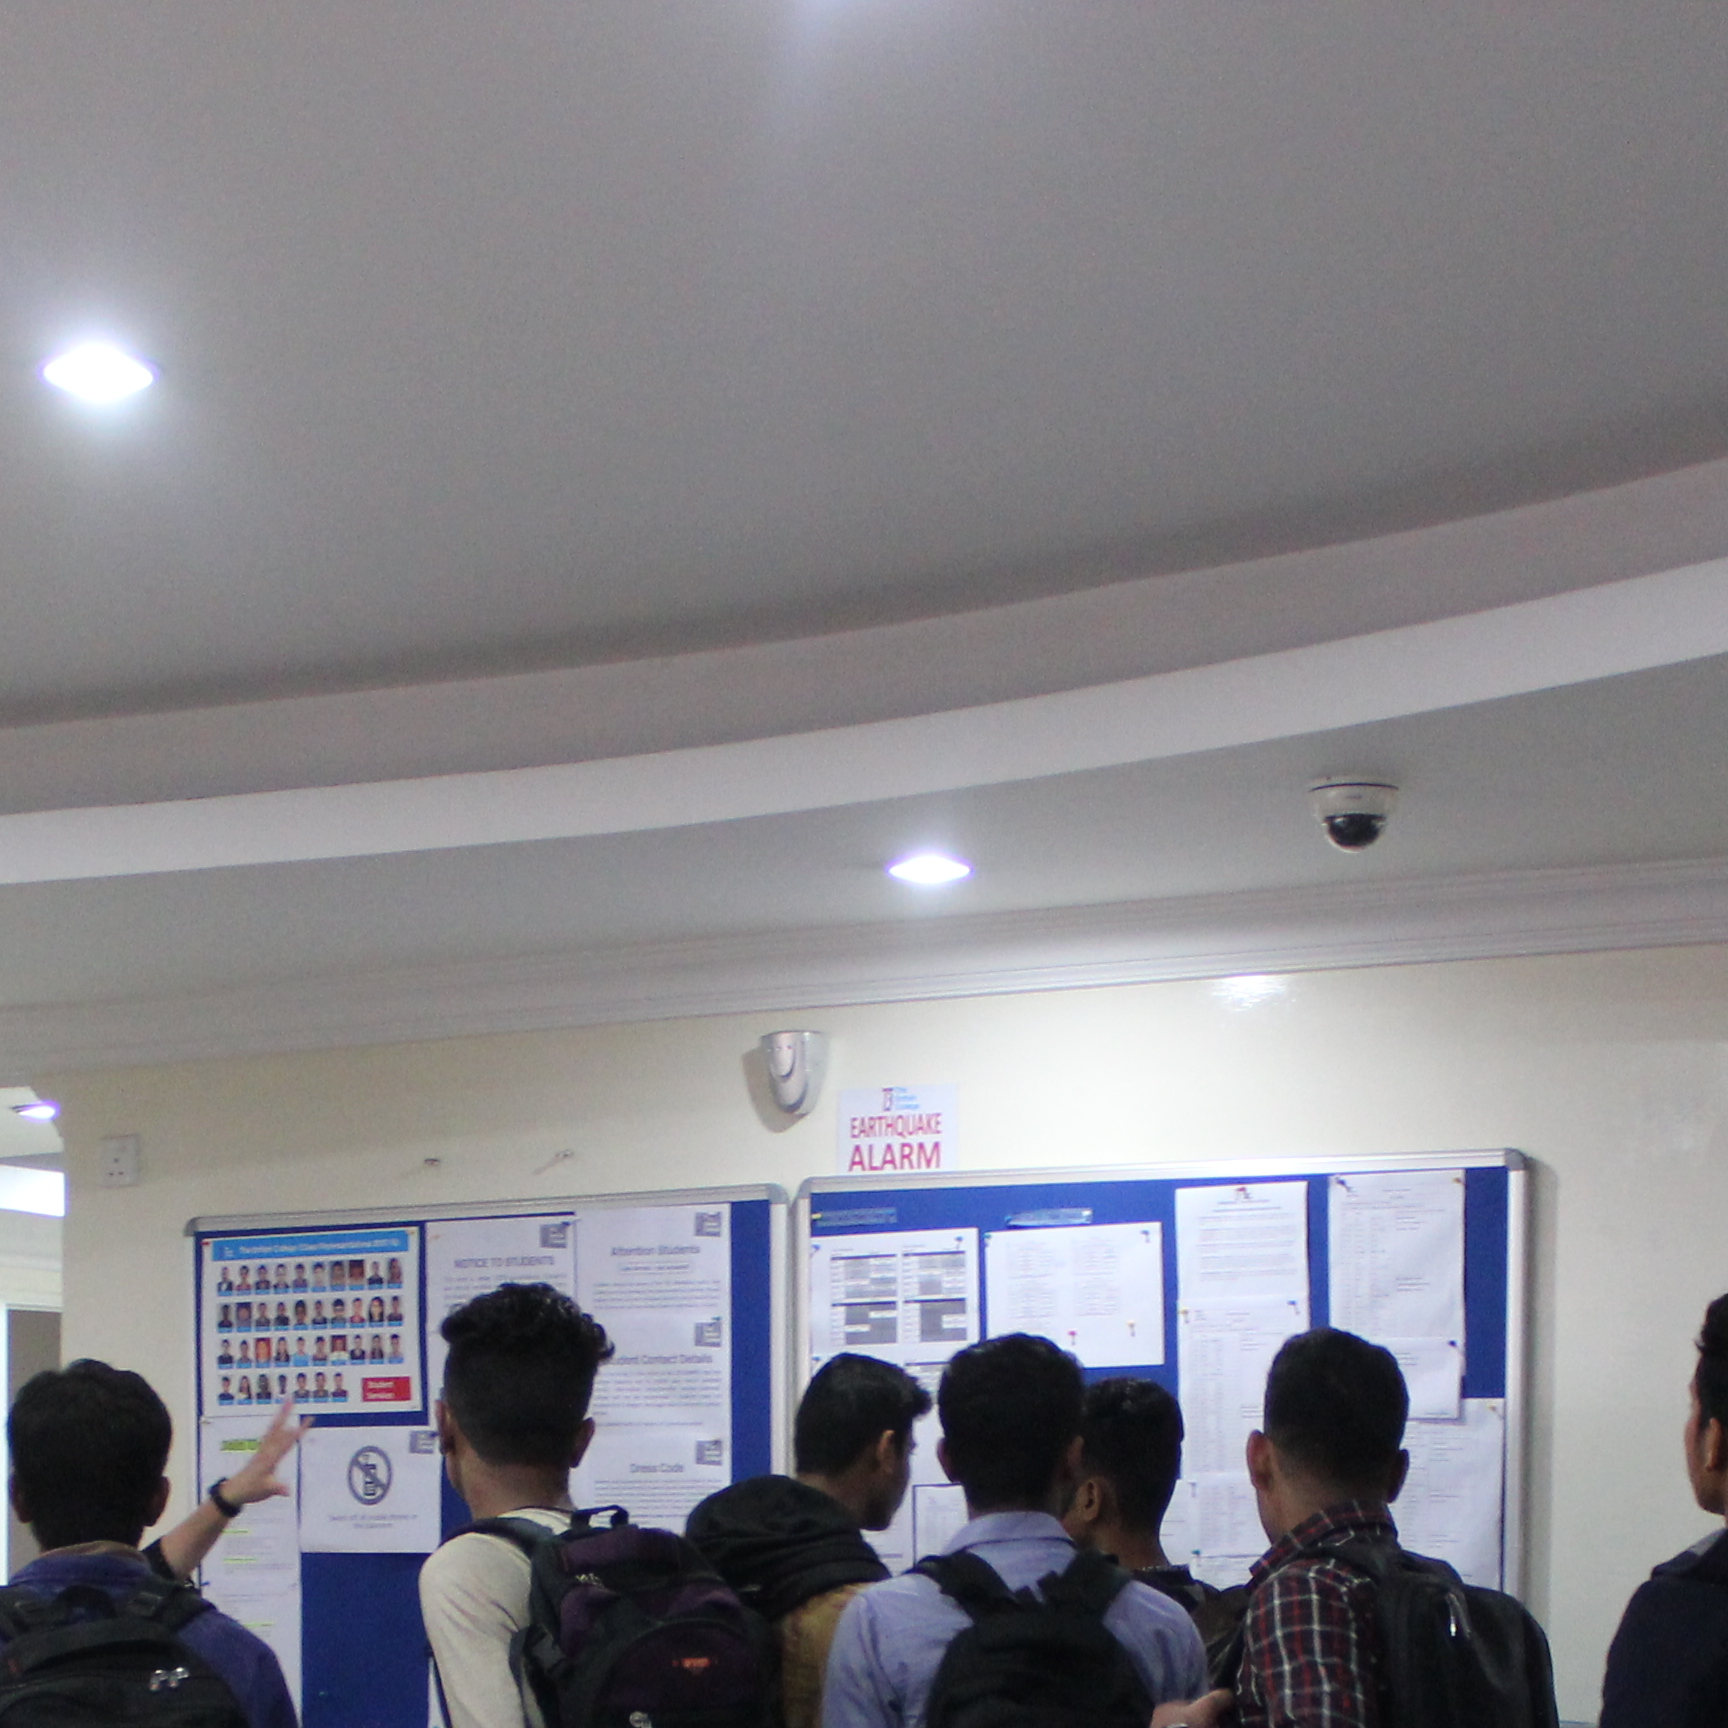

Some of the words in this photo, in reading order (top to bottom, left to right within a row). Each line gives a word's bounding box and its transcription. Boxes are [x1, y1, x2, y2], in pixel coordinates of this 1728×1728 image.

[850, 1112, 942, 1139] EARTHQUAKE
[848, 1141, 941, 1172] ALARM
[611, 1246, 655, 1256] Attention
[658, 1244, 700, 1255] Students
[454, 1257, 489, 1268] NOTICE
[491, 1256, 504, 1267] TO
[506, 1255, 554, 1267] STUDENTS
[658, 1463, 683, 1473] Code
